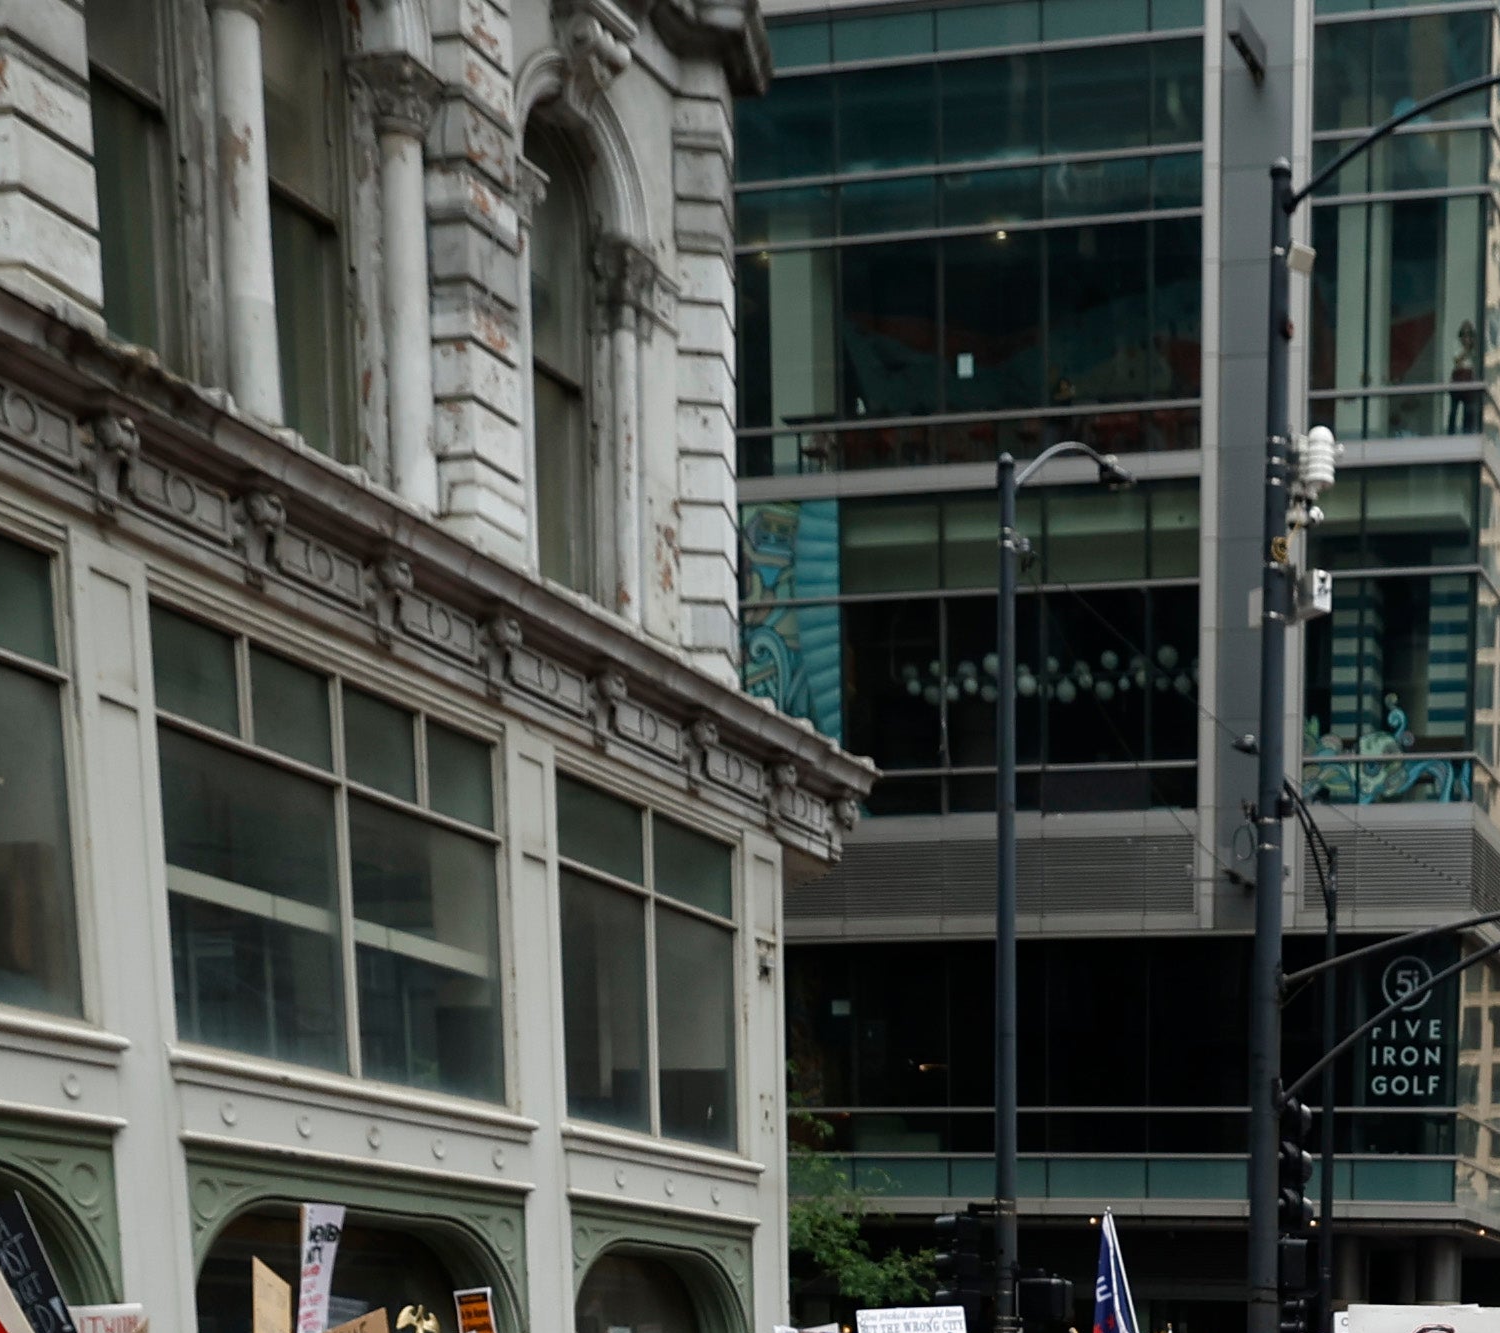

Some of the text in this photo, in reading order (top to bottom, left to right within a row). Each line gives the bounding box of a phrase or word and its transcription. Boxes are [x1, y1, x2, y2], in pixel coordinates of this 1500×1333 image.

[1371, 1046, 1441, 1067] IRON
[1371, 1075, 1441, 1096] GOLF
[903, 1321, 941, 1333] WRONG
[943, 1319, 965, 1331] CITY
